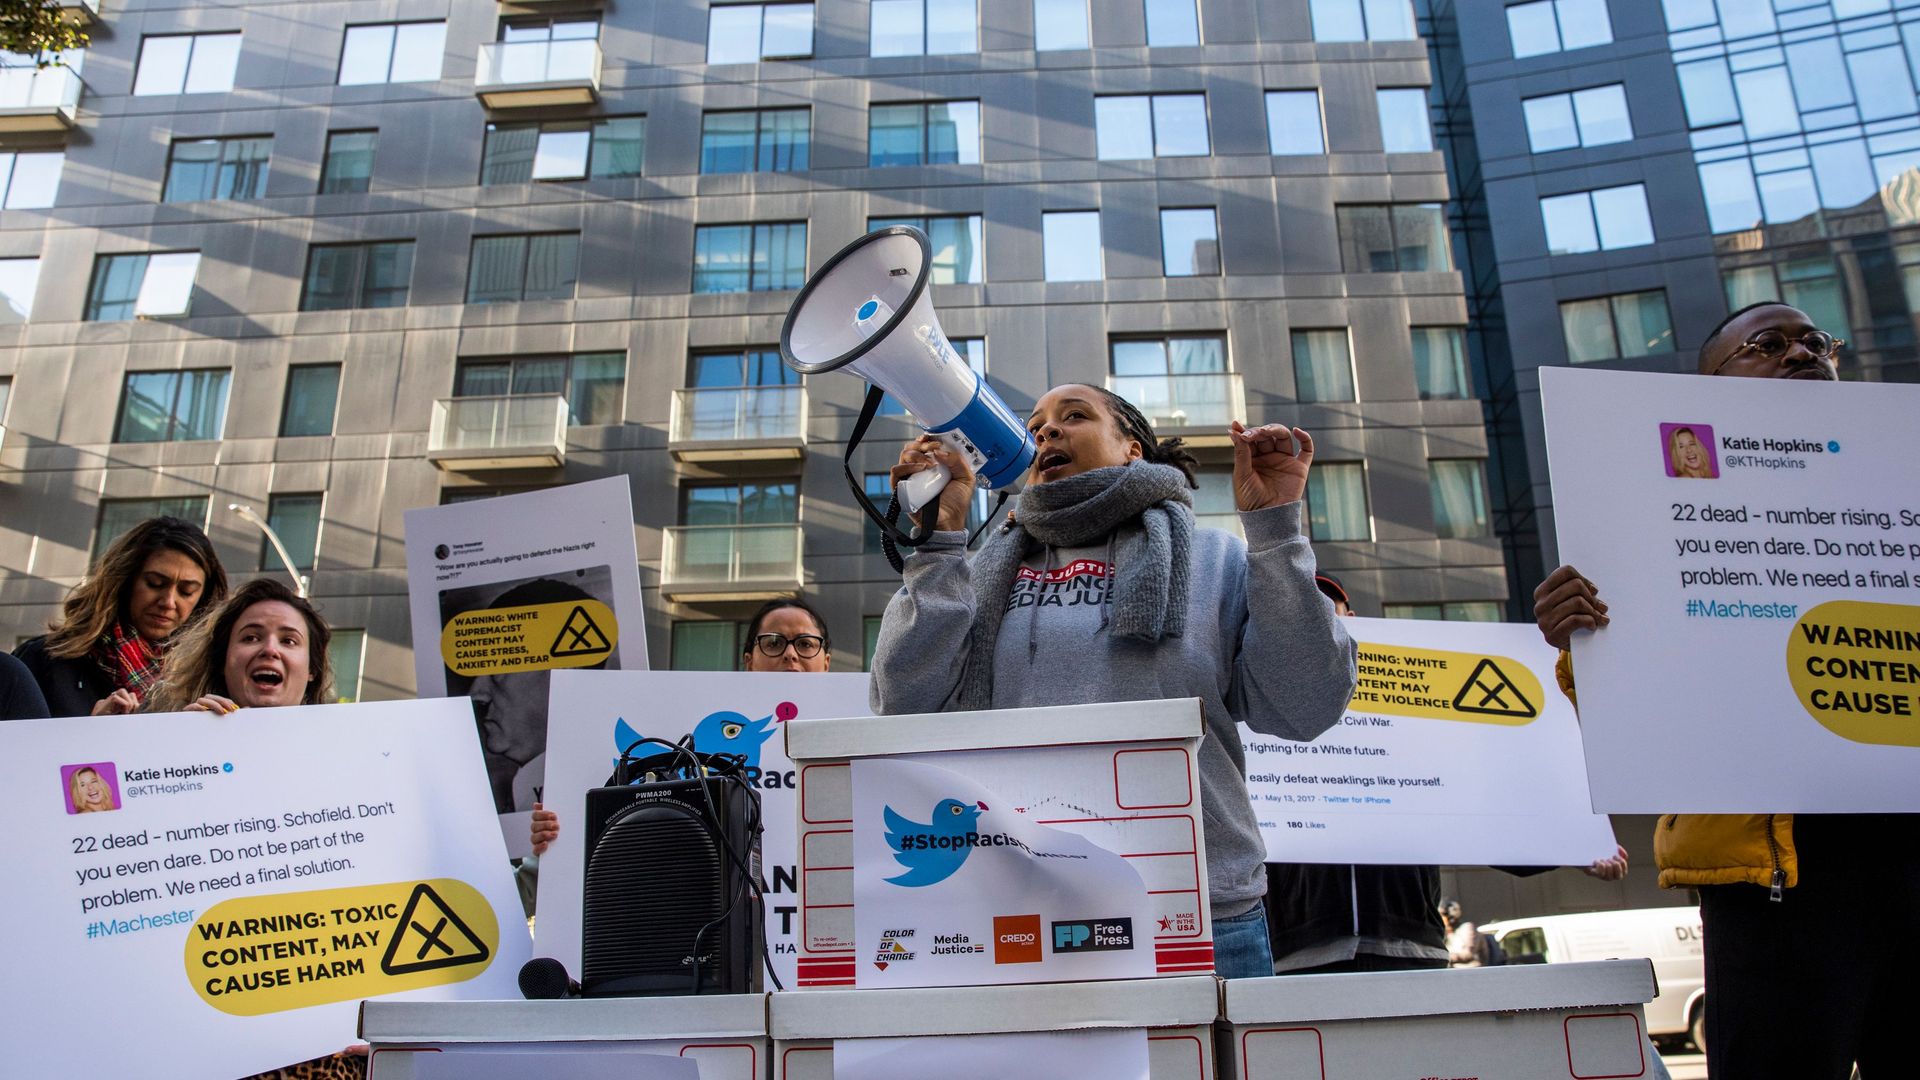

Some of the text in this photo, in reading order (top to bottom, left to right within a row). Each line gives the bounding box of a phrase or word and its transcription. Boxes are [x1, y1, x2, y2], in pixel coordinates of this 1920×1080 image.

[1722, 436, 1823, 456] Katie Hopkins
[1725, 455, 1806, 471] @KTHopkins
[1671, 503, 1697, 522] 22
[1700, 504, 1748, 524] dead
[1766, 507, 1836, 526] number
[1841, 508, 1896, 530] rising.
[480, 557, 502, 565] actually
[504, 554, 521, 562] going
[530, 549, 551, 558] defend
[581, 541, 595, 550] right
[1675, 538, 1711, 557] you
[1714, 539, 1760, 556] even
[1763, 537, 1810, 557] dare.
[1814, 538, 1841, 556] Do
[1846, 541, 1878, 557] not
[1880, 539, 1905, 557] be
[1680, 567, 1762, 589] problem.
[1767, 569, 1798, 587] We
[1803, 570, 1850, 587] need
[1855, 574, 1868, 588] a
[1870, 571, 1909, 588] final
[1685, 599, 1798, 619] #Machester
[455, 611, 538, 626] WARNING: WHITE
[455, 624, 522, 637] SUPREMACIST
[455, 635, 525, 648] CONTENT MAY
[456, 646, 529, 659] CAUSE STRESS,
[456, 655, 549, 670] ANXIETY AND FEAR
[1403, 656, 1448, 669] WHITE
[1358, 665, 1425, 680] REMACIST
[1401, 682, 1430, 694] MAY
[1382, 693, 1451, 709] VIOLENCE
[1810, 688, 1911, 716] CAUSE
[1344, 716, 1368, 726] Civil
[1369, 717, 1394, 727] War.
[1250, 743, 1292, 755] fighting
[1294, 744, 1308, 753] for
[1320, 745, 1352, 755] White
[1354, 746, 1390, 756] future.
[124, 763, 220, 783] Katie Hopkins
[1249, 774, 1444, 788] easily defeat weaklings like yourself.
[127, 780, 203, 798] @KTHopkins
[635, 789, 672, 799] PWMA200
[1265, 795, 1281, 803] May
[1283, 795, 1296, 803] 13,
[605, 803, 636, 825] RECHARGEABLE
[635, 798, 658, 806] PORTABLE
[681, 802, 702, 815] AMPLIFIER
[72, 836, 99, 854] 22
[102, 830, 149, 852] dead
[166, 820, 231, 844] number
[234, 814, 281, 839] rising.
[283, 805, 356, 830] Schofield.
[358, 800, 395, 819] Don't
[1286, 821, 1303, 829] 180
[76, 828, 365, 886] you even dare. Do not be part of the
[81, 854, 356, 915] problem. We need a final solution.
[86, 907, 195, 939] #Machester
[199, 902, 399, 941] WARNING: TOXIC
[1094, 923, 1123, 934] Free
[883, 929, 915, 938] COLOR
[934, 933, 969, 945] Media
[1000, 933, 1035, 943] CREDO
[1055, 924, 1090, 948] FP
[1094, 935, 1129, 946] Press
[202, 930, 381, 969] CONTENT, MAY
[880, 942, 893, 950] OF
[931, 944, 973, 955] Justice
[876, 953, 915, 962] CHANGE
[205, 958, 364, 997] CAUSE HARM
